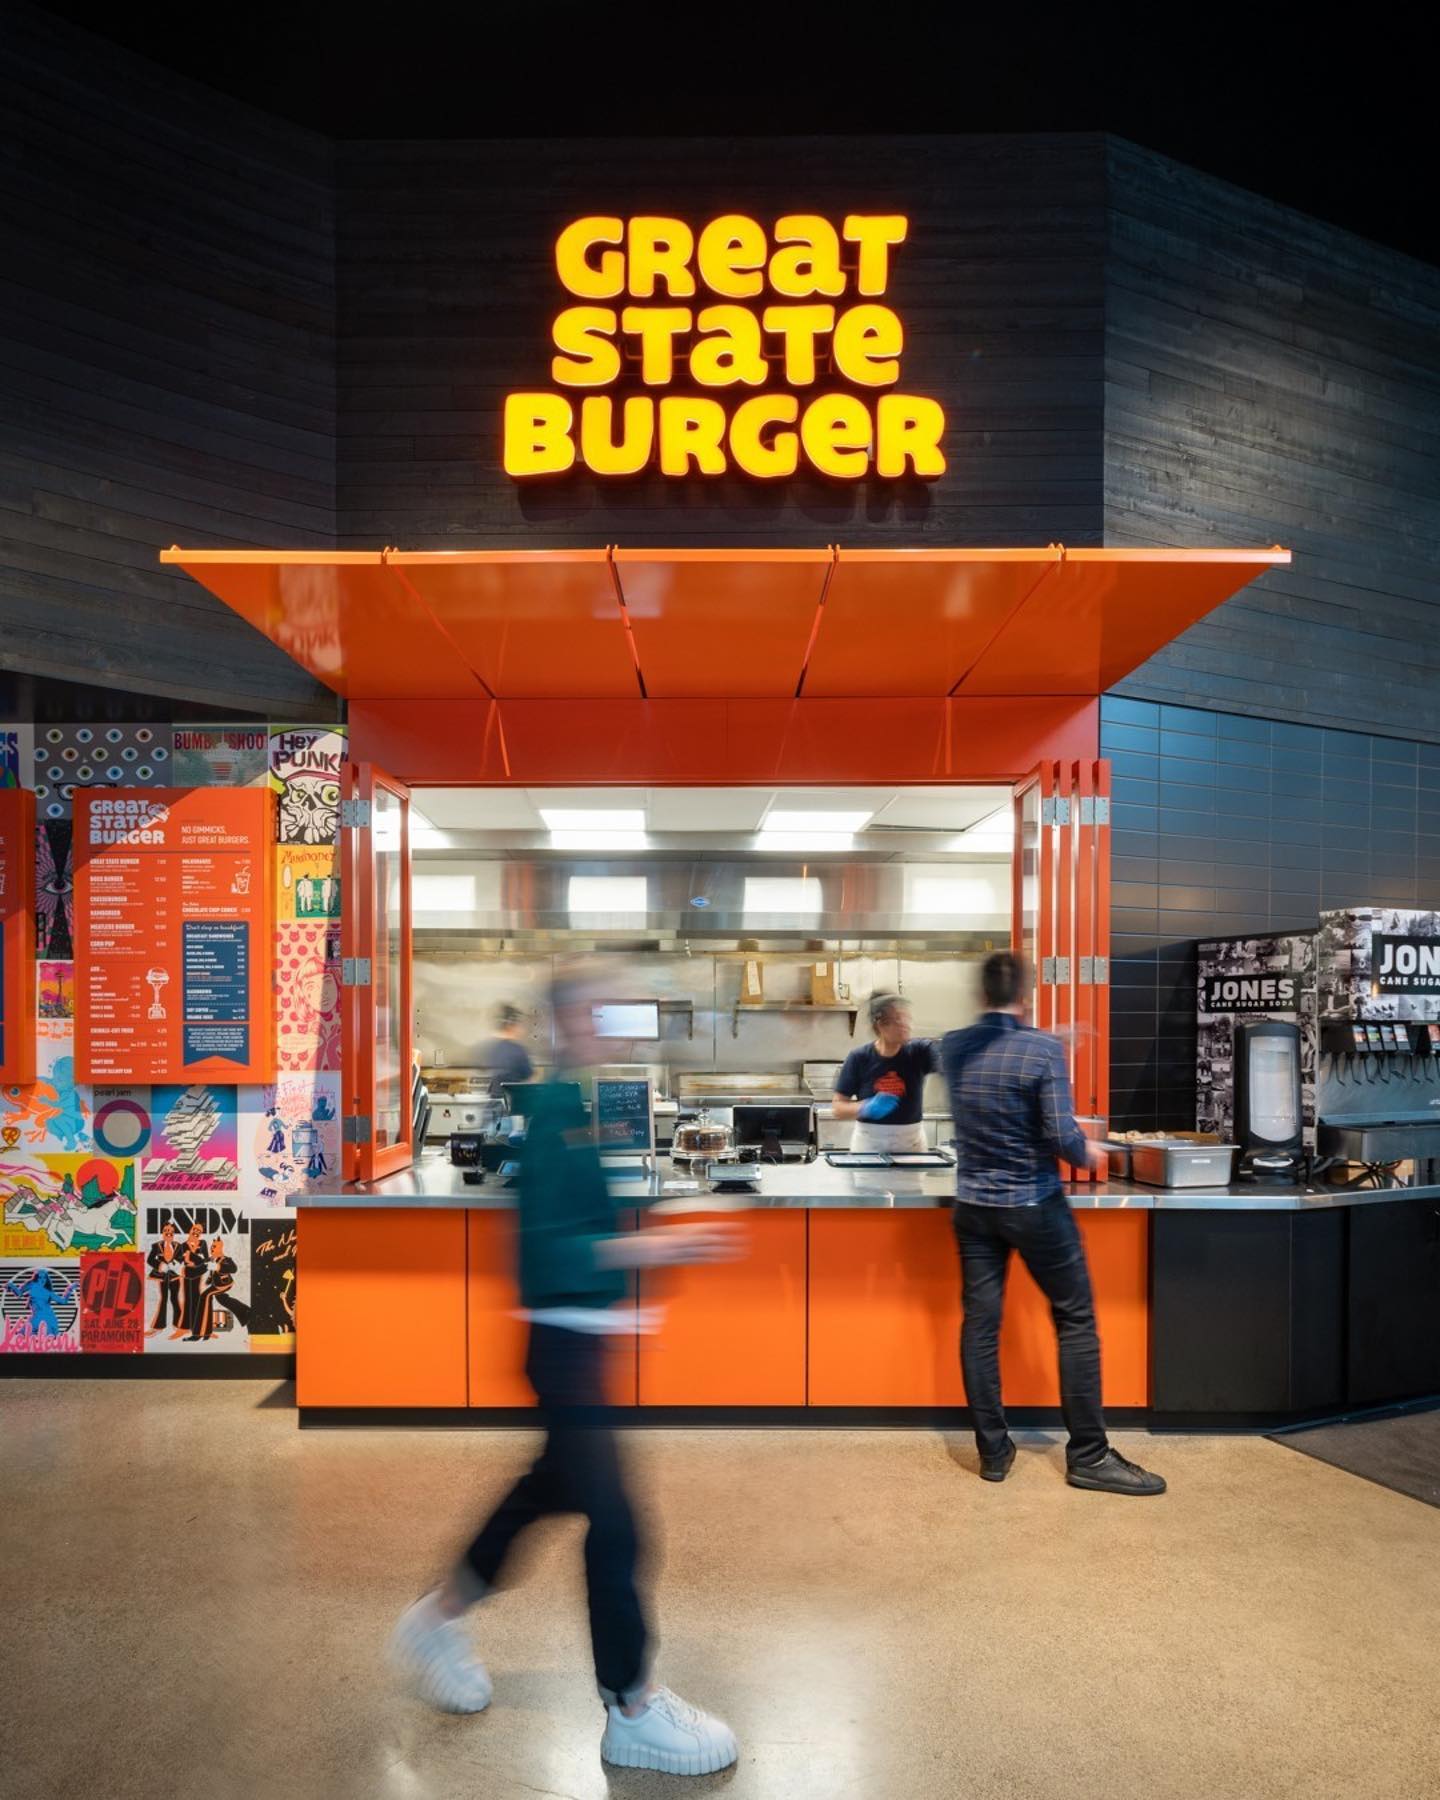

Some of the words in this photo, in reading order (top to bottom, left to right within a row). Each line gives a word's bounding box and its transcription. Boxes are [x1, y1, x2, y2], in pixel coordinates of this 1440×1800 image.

[555, 215, 908, 298] GReaT
[552, 304, 904, 386] STaTe
[503, 393, 947, 478] BURGeR
[89, 830, 165, 845] BURGeR
[1379, 976, 1409, 985] CANE
[1210, 979, 1294, 1001] JONES
[1236, 1000, 1265, 1008] SUGAR
[81, 1330, 140, 1343] PARAMOUNT
